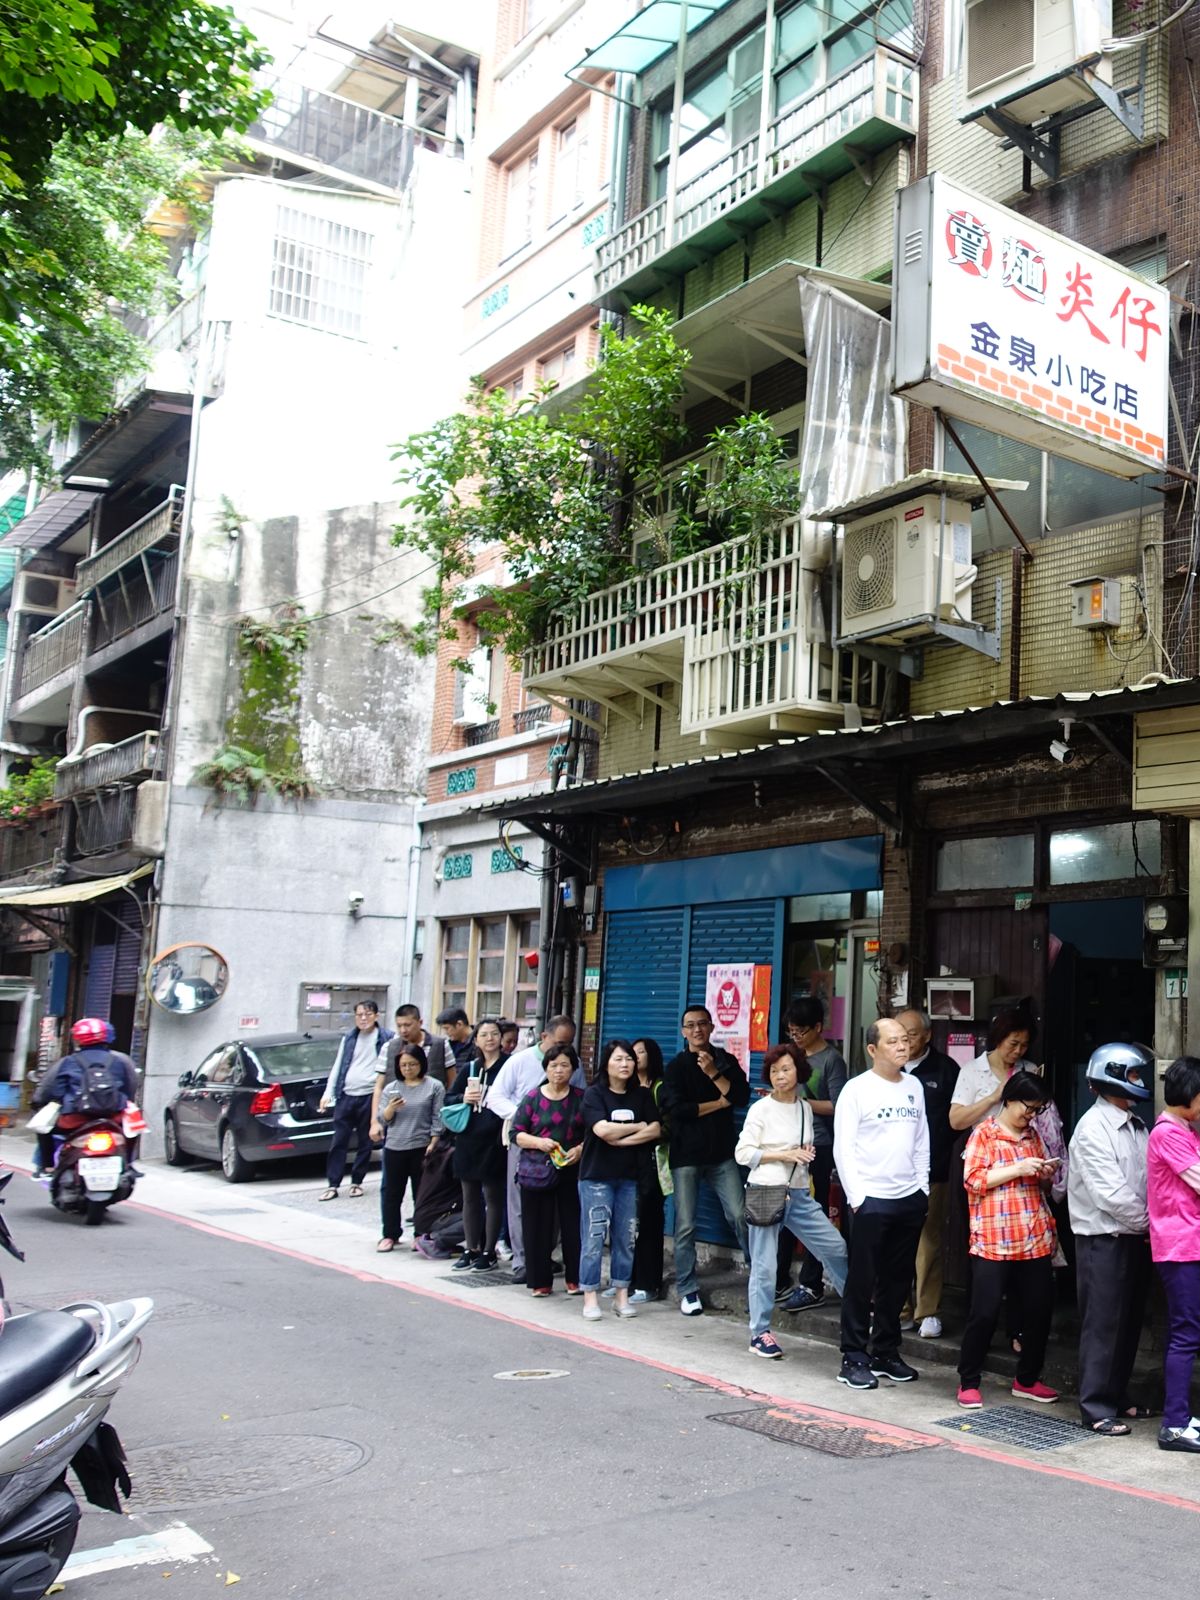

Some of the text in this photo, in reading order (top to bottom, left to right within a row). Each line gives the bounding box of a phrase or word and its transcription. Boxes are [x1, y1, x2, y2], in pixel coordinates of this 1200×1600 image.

[946, 208, 1163, 363] 賣麵炎仔
[970, 321, 1139, 420] 金泉小吃店
